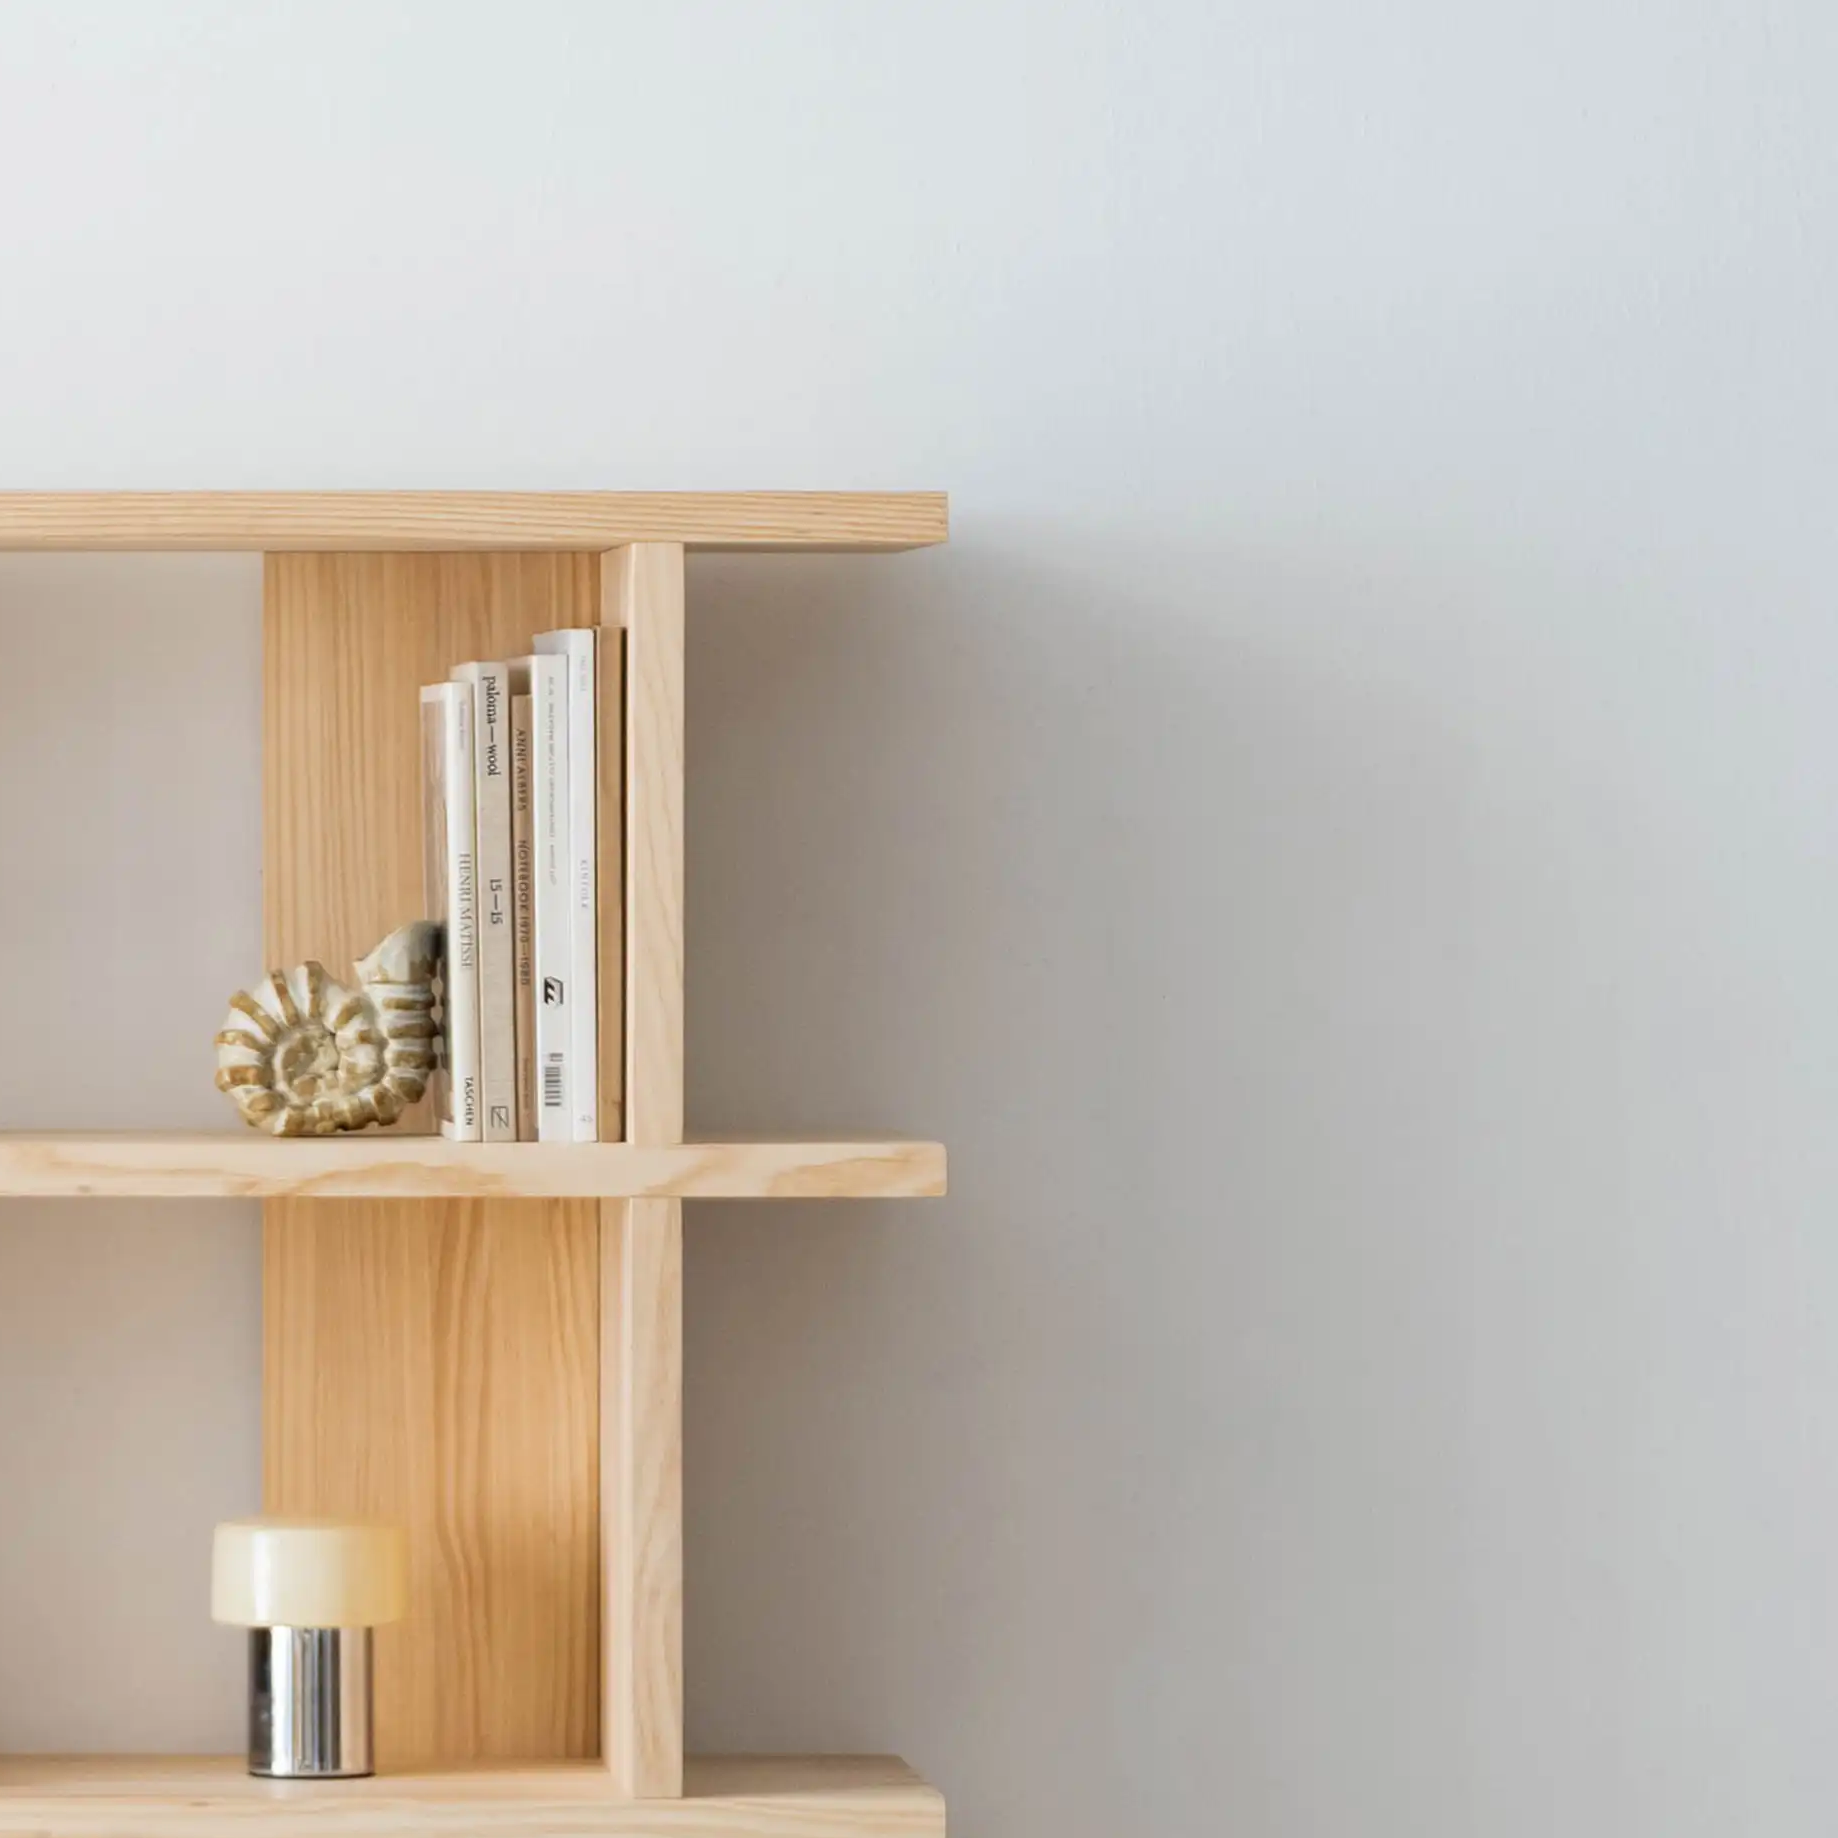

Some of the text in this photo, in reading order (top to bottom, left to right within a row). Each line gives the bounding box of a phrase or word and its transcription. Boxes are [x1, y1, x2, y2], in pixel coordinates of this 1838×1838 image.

[459, 853, 474, 967] HENRI MATISSE
[518, 840, 530, 911] NOTEBOOK
[465, 1076, 474, 1126] TASCHEN
